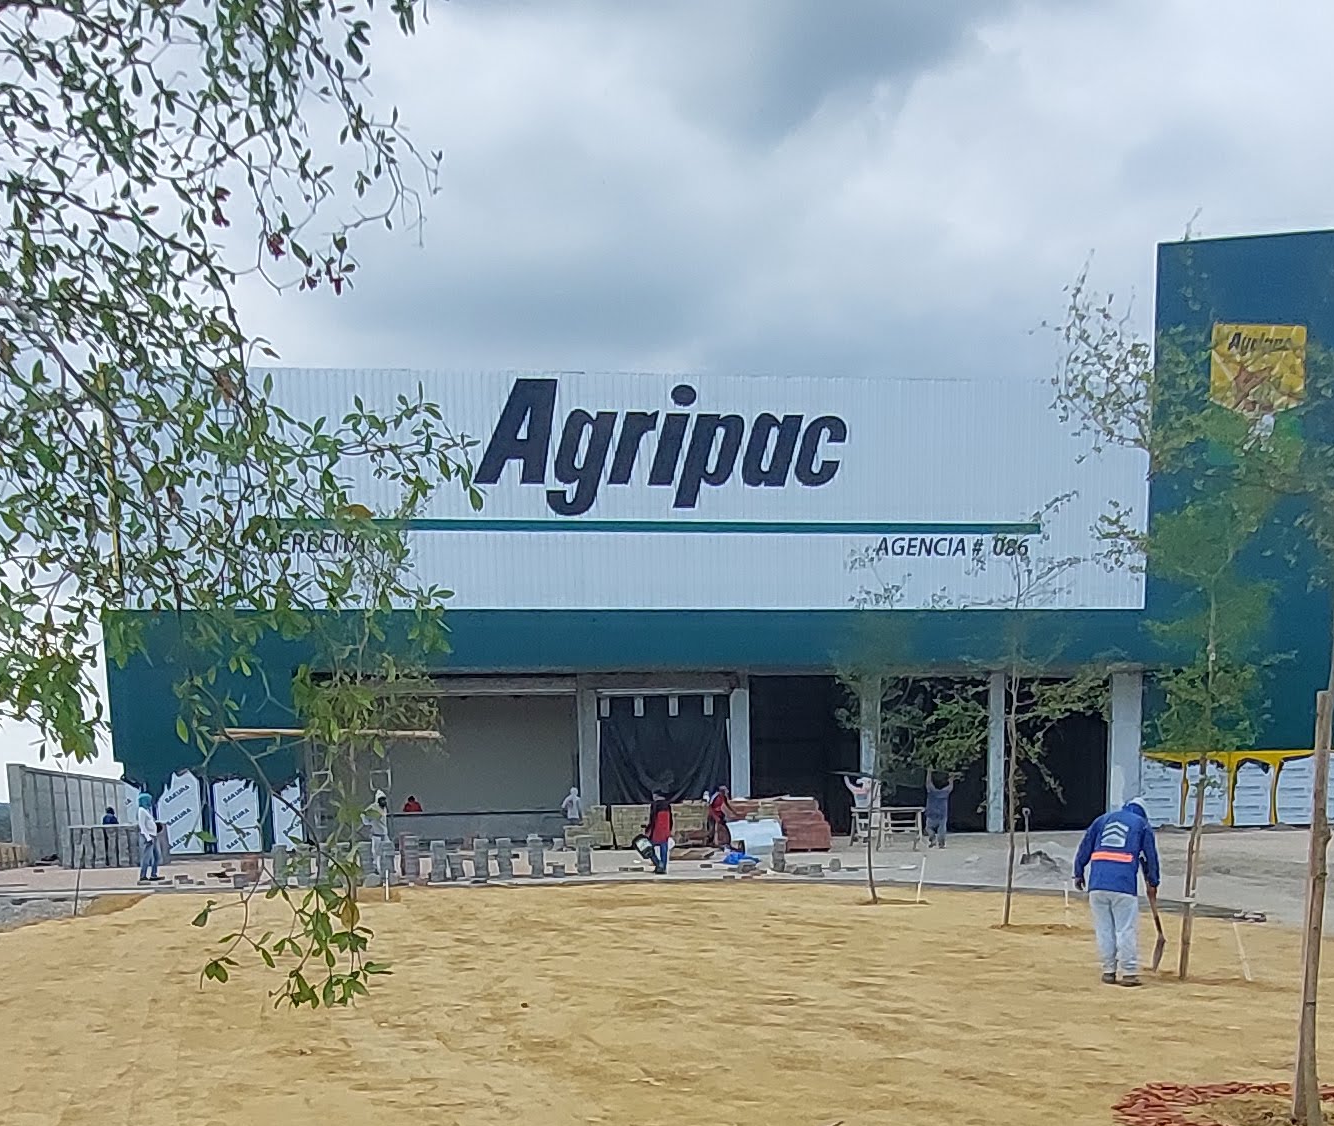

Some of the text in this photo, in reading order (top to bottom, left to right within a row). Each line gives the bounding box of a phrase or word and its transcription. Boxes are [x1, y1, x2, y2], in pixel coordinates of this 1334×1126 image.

[473, 378, 848, 516] Agripac
[875, 536, 1030, 557] AGENCIA # 086
[226, 831, 251, 849] SAKA
